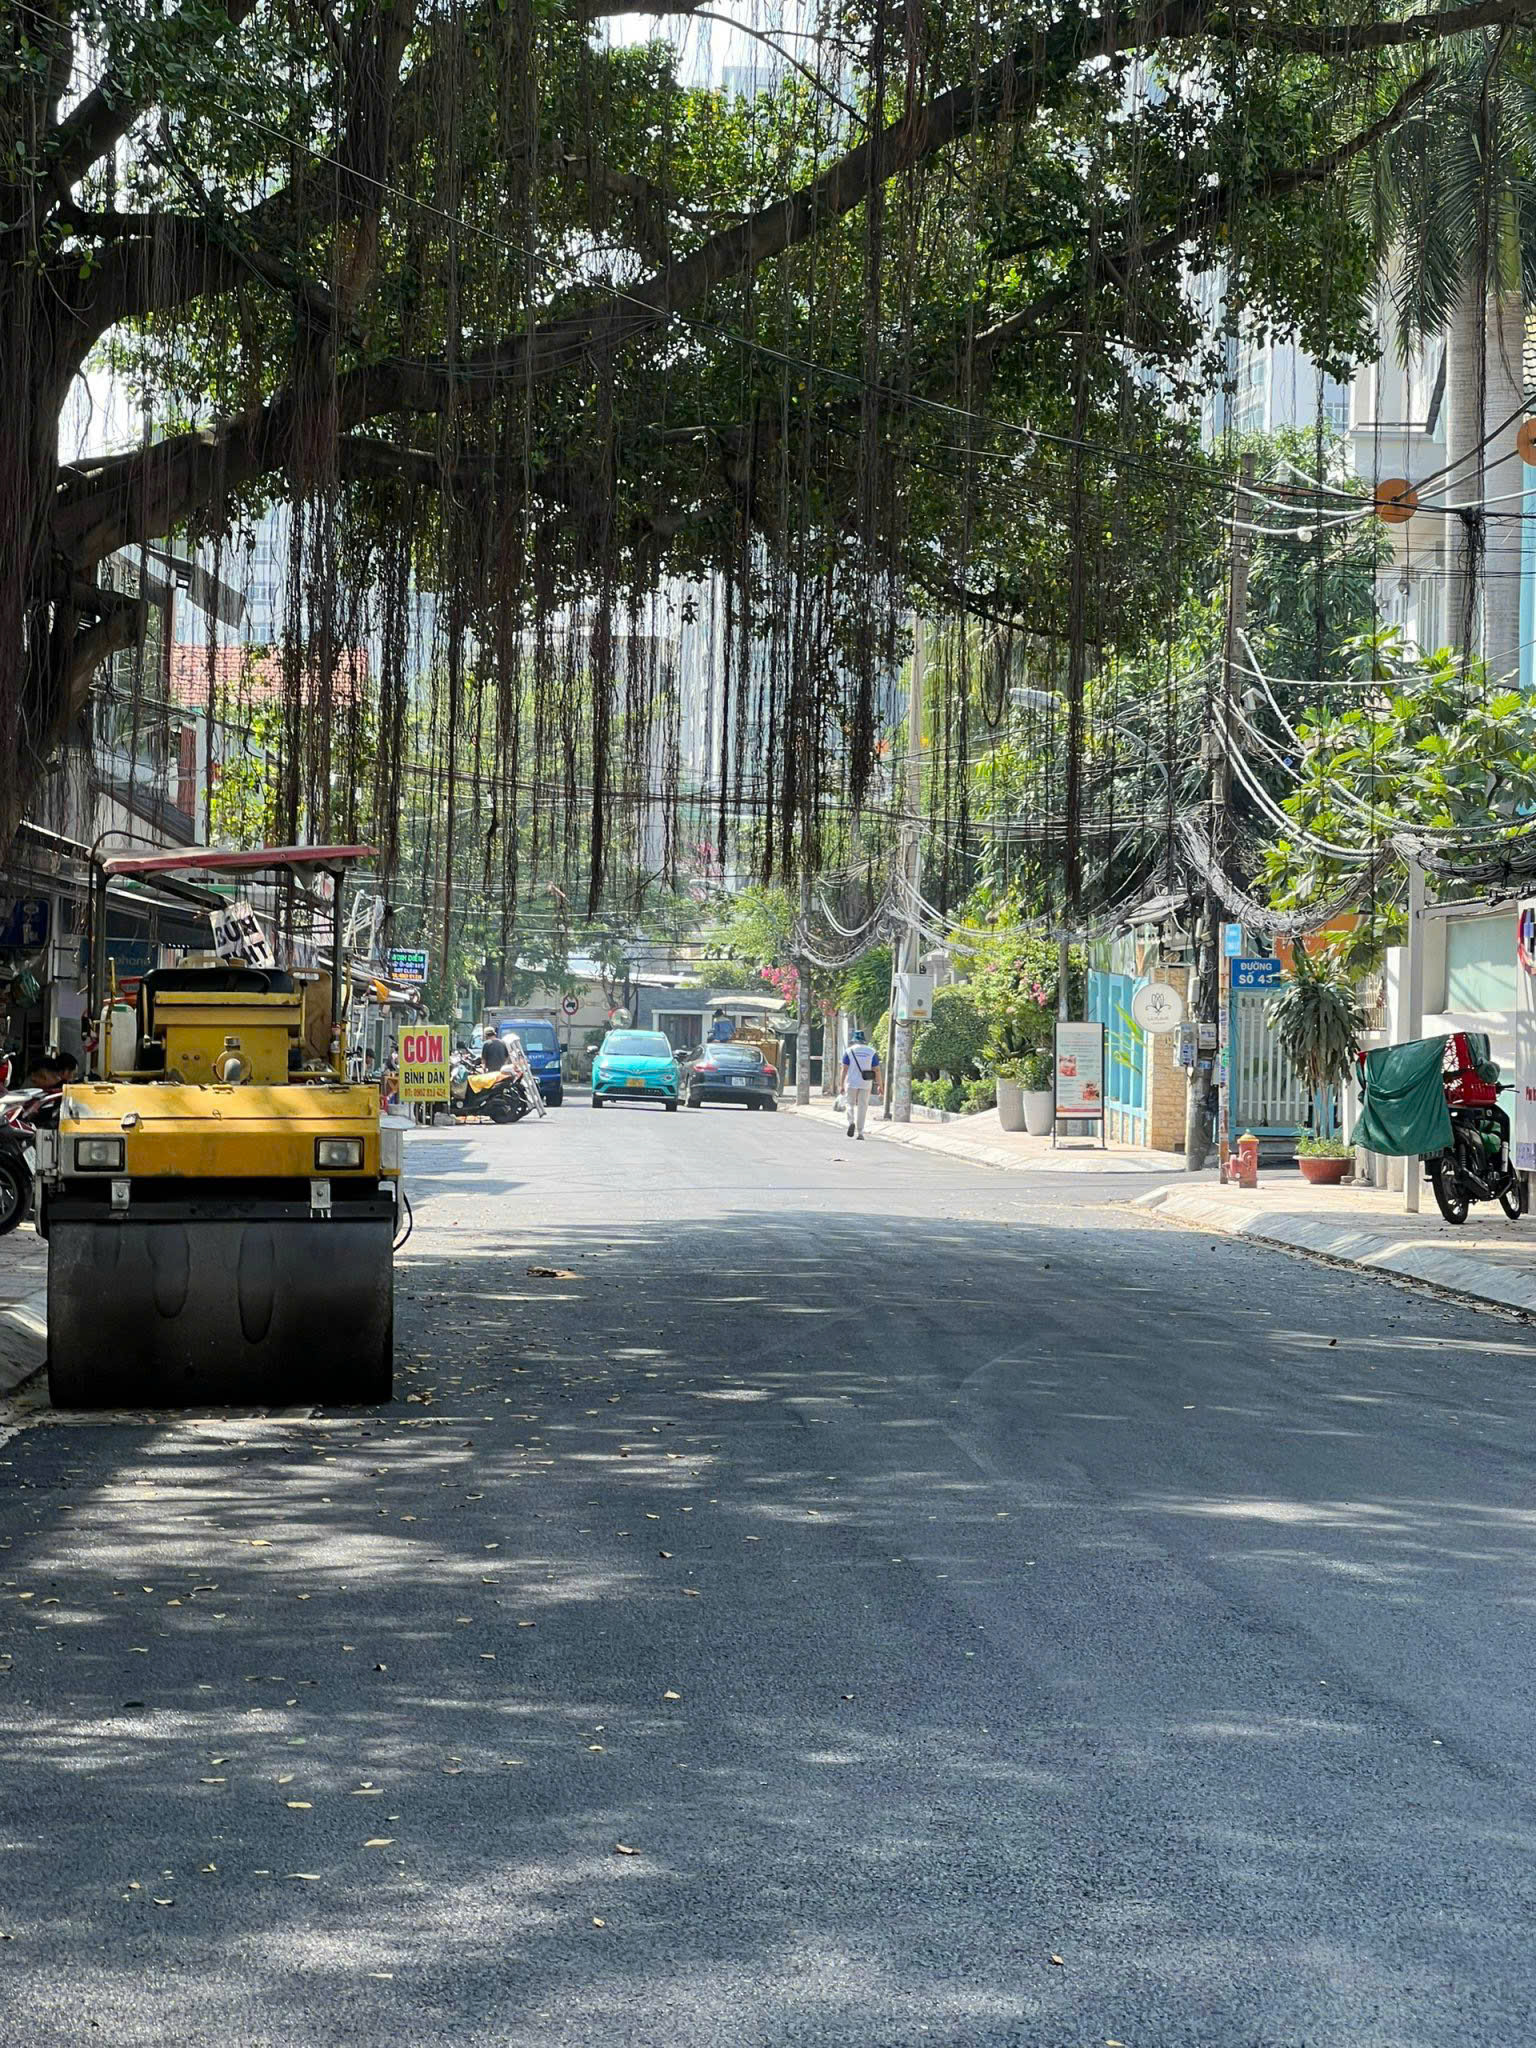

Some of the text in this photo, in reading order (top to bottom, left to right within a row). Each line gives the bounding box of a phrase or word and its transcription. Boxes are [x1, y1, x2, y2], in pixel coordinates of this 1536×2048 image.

[1240, 961, 1272, 970] ĐƯỜNG
[1239, 971, 1254, 984] SỐ
[404, 1030, 443, 1063] CƠM
[405, 1068, 445, 1084] BÌNH DÂN
